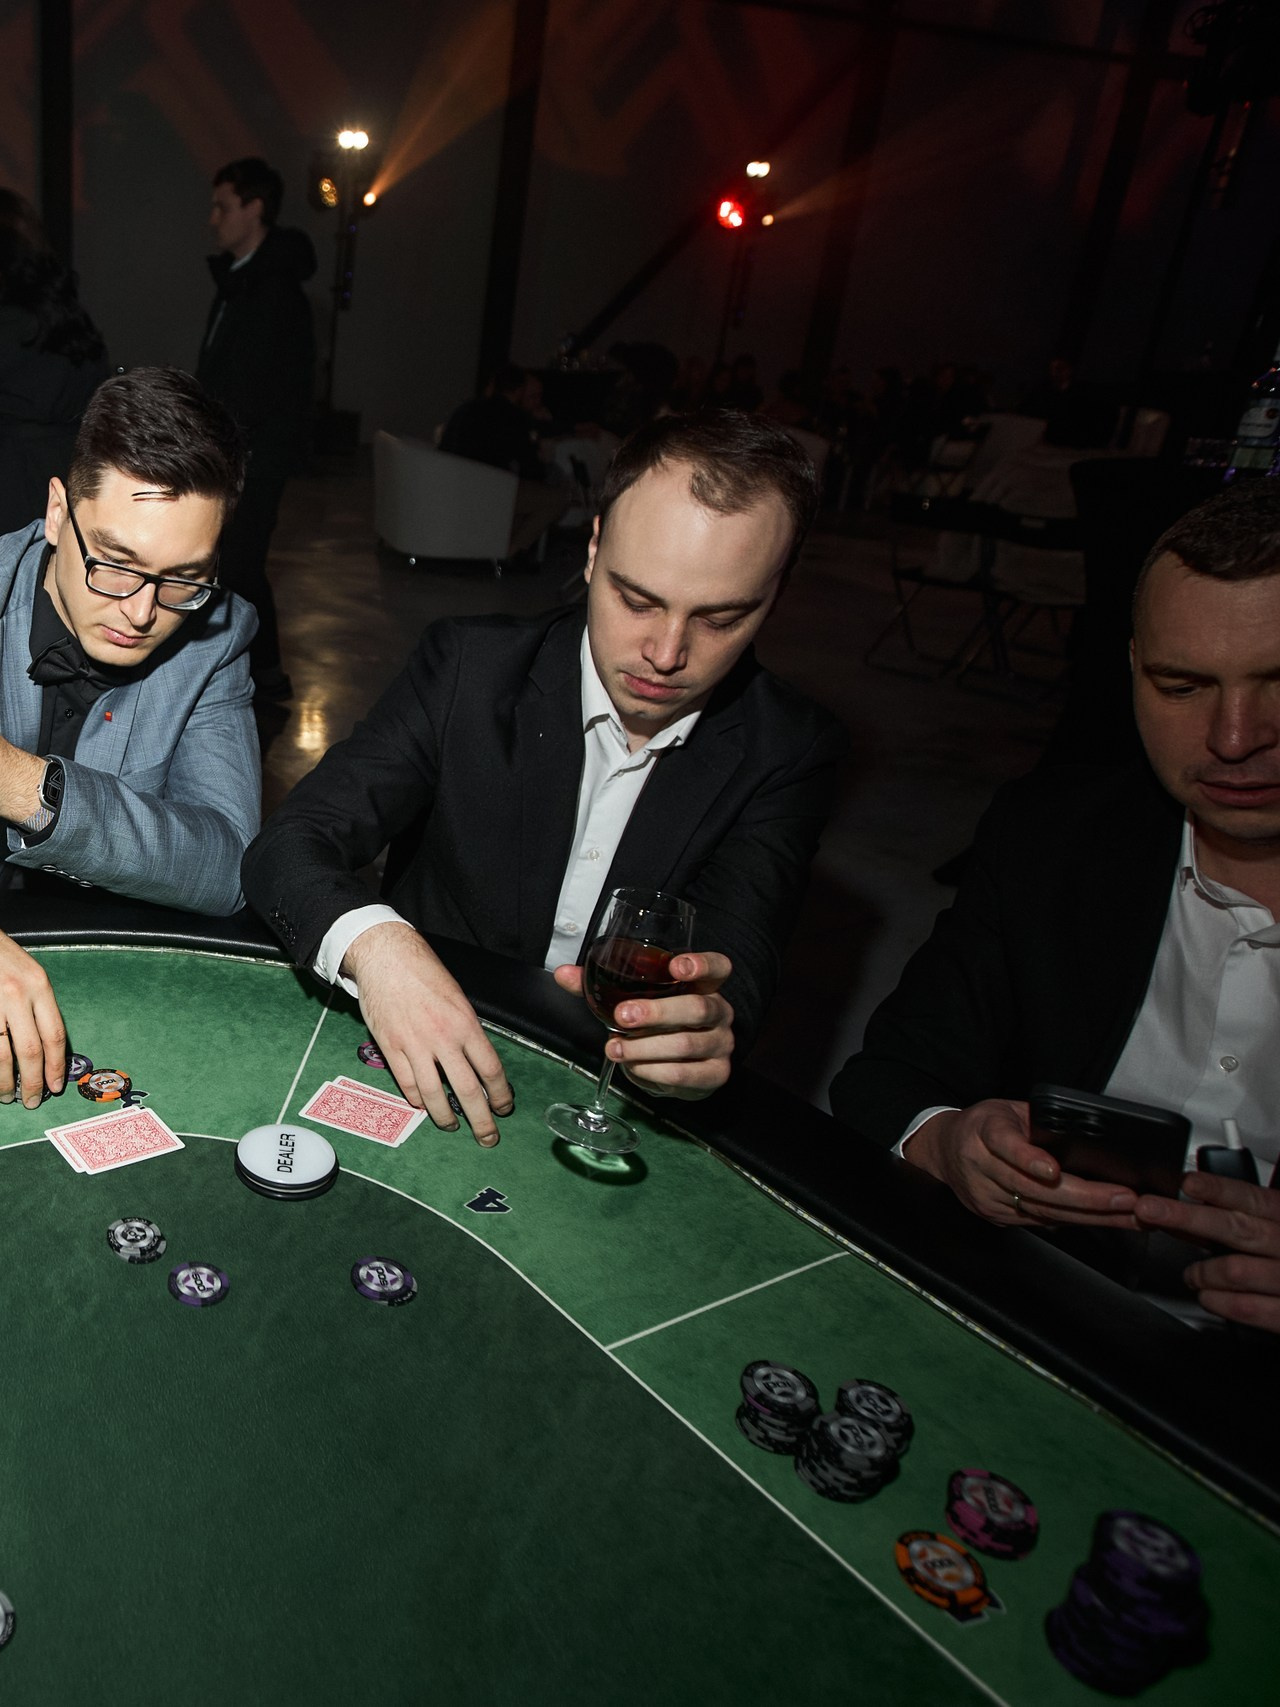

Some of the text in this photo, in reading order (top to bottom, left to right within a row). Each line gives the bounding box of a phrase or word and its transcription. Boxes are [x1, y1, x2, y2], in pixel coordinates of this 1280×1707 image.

[277, 1133, 296, 1173] DEALER
[464, 1186, 513, 1214] 4
[192, 1272, 205, 1291] 500
[376, 1267, 388, 1286] 500
